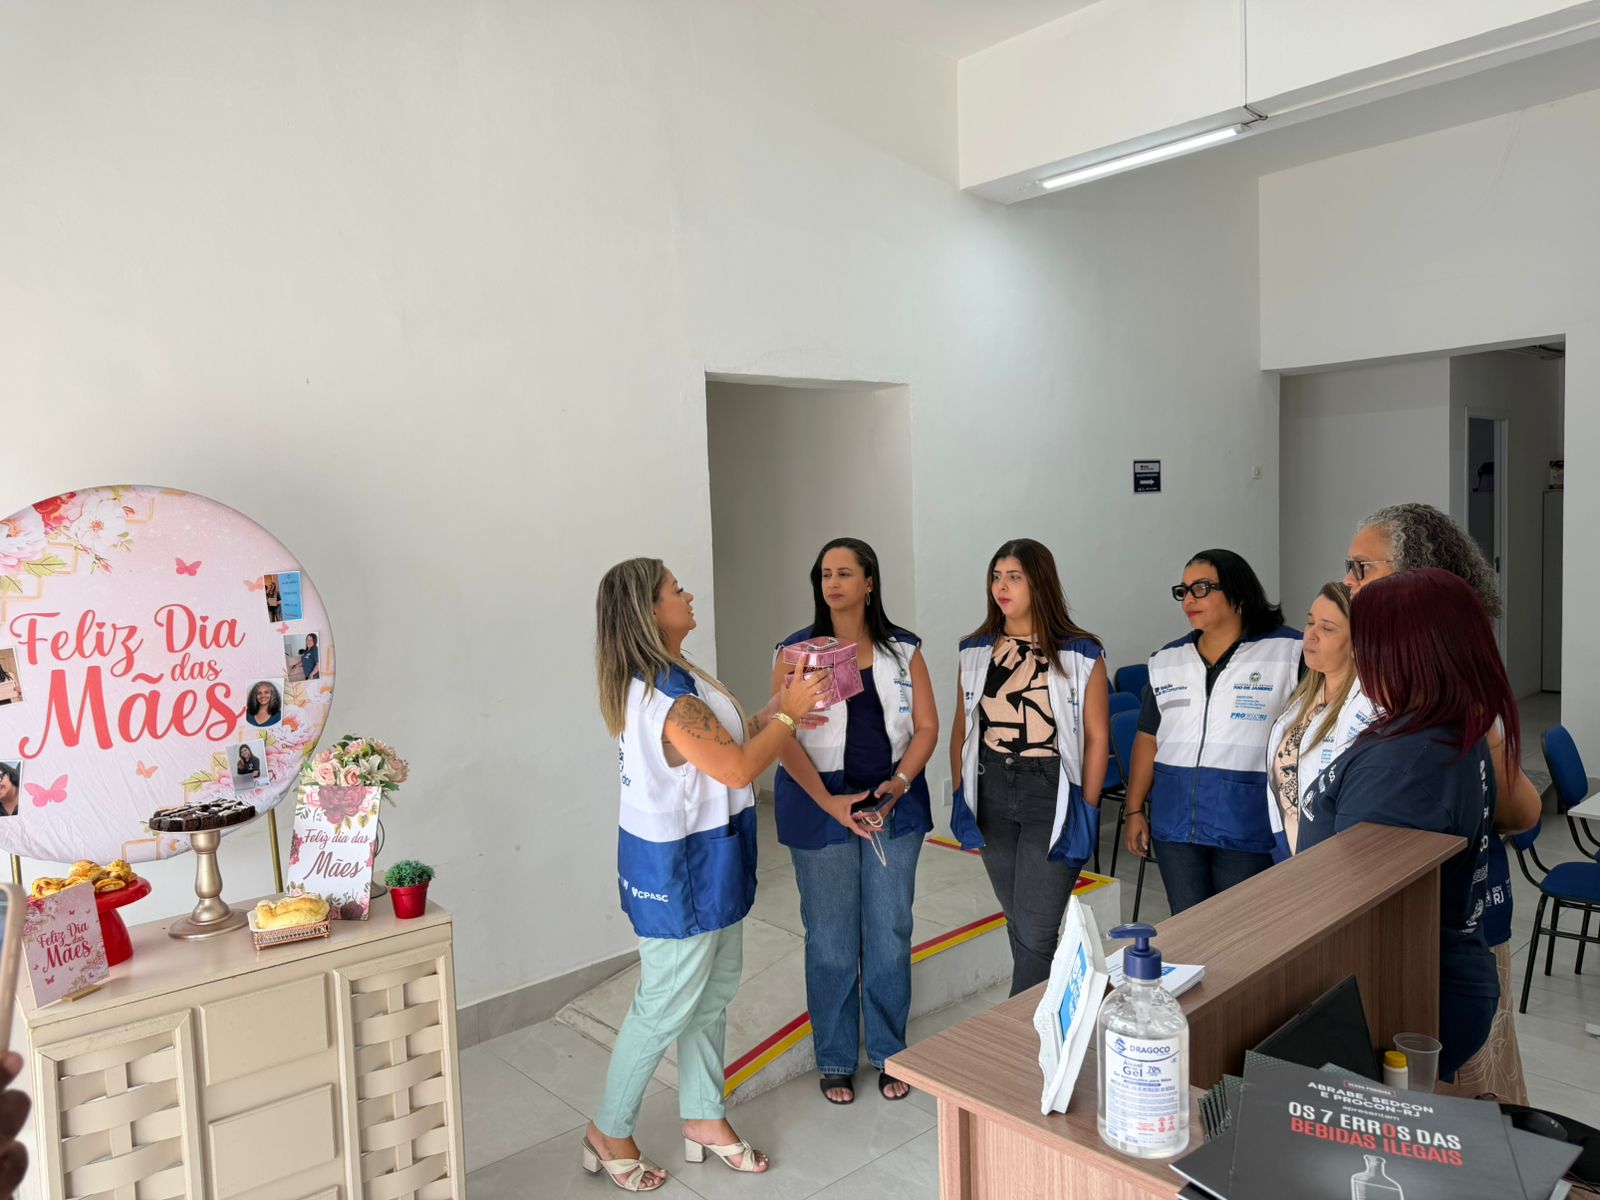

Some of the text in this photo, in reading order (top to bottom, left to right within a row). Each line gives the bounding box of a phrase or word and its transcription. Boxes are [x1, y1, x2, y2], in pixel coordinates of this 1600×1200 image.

[10, 603, 246, 677] Feliz Dia
[171, 652, 223, 682] das
[18, 665, 247, 760] Mães
[304, 828, 370, 850] Feliz dia das
[303, 850, 364, 880] Mães
[638, 890, 669, 902] CPASC
[1493, 890, 1505, 905] RJ
[37, 922, 89, 949] Feliz Dia
[72, 935, 85, 944] das
[42, 940, 92, 973] Mães
[1129, 1045, 1171, 1054] DRAGOCO
[1122, 1065, 1143, 1077] Gel
[1307, 1081, 1434, 1114] ABRABE, SEDCON
[1320, 1091, 1420, 1118] E PROCON-RJ
[1288, 1101, 1462, 1150] OS 7 ERROS DAS
[1342, 1105, 1400, 1121] apresentam
[1291, 1117, 1464, 1167] BEBIDAS ILEGAIS
